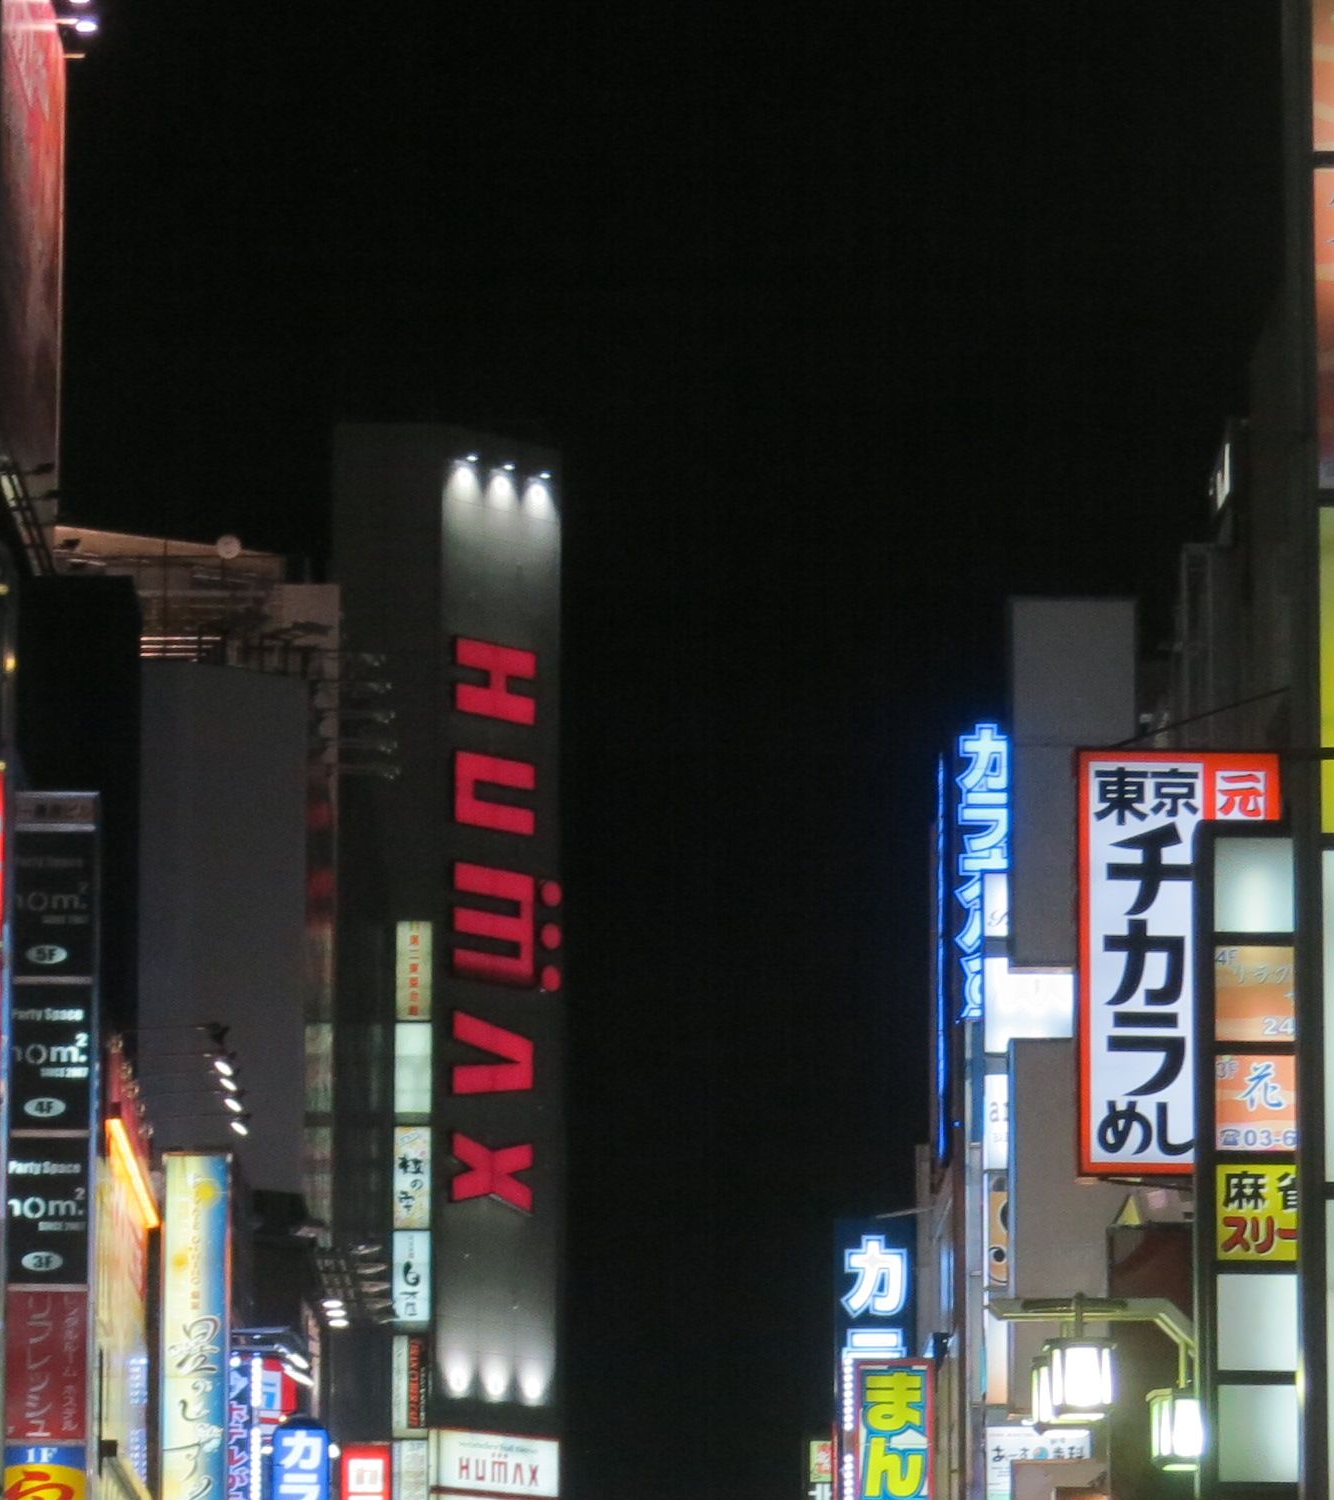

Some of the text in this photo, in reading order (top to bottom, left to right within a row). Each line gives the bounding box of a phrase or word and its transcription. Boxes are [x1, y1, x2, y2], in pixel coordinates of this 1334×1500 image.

[1095, 767, 1199, 827] 東京
[451, 636, 562, 1214] HUMAX
[1104, 822, 1195, 1097] チカラ
[1242, 1060, 1284, 1110] 花
[1097, 1101, 1196, 1157] めし
[26, 1447, 59, 1463] 1F
[458, 1453, 539, 1486] HUMAX
